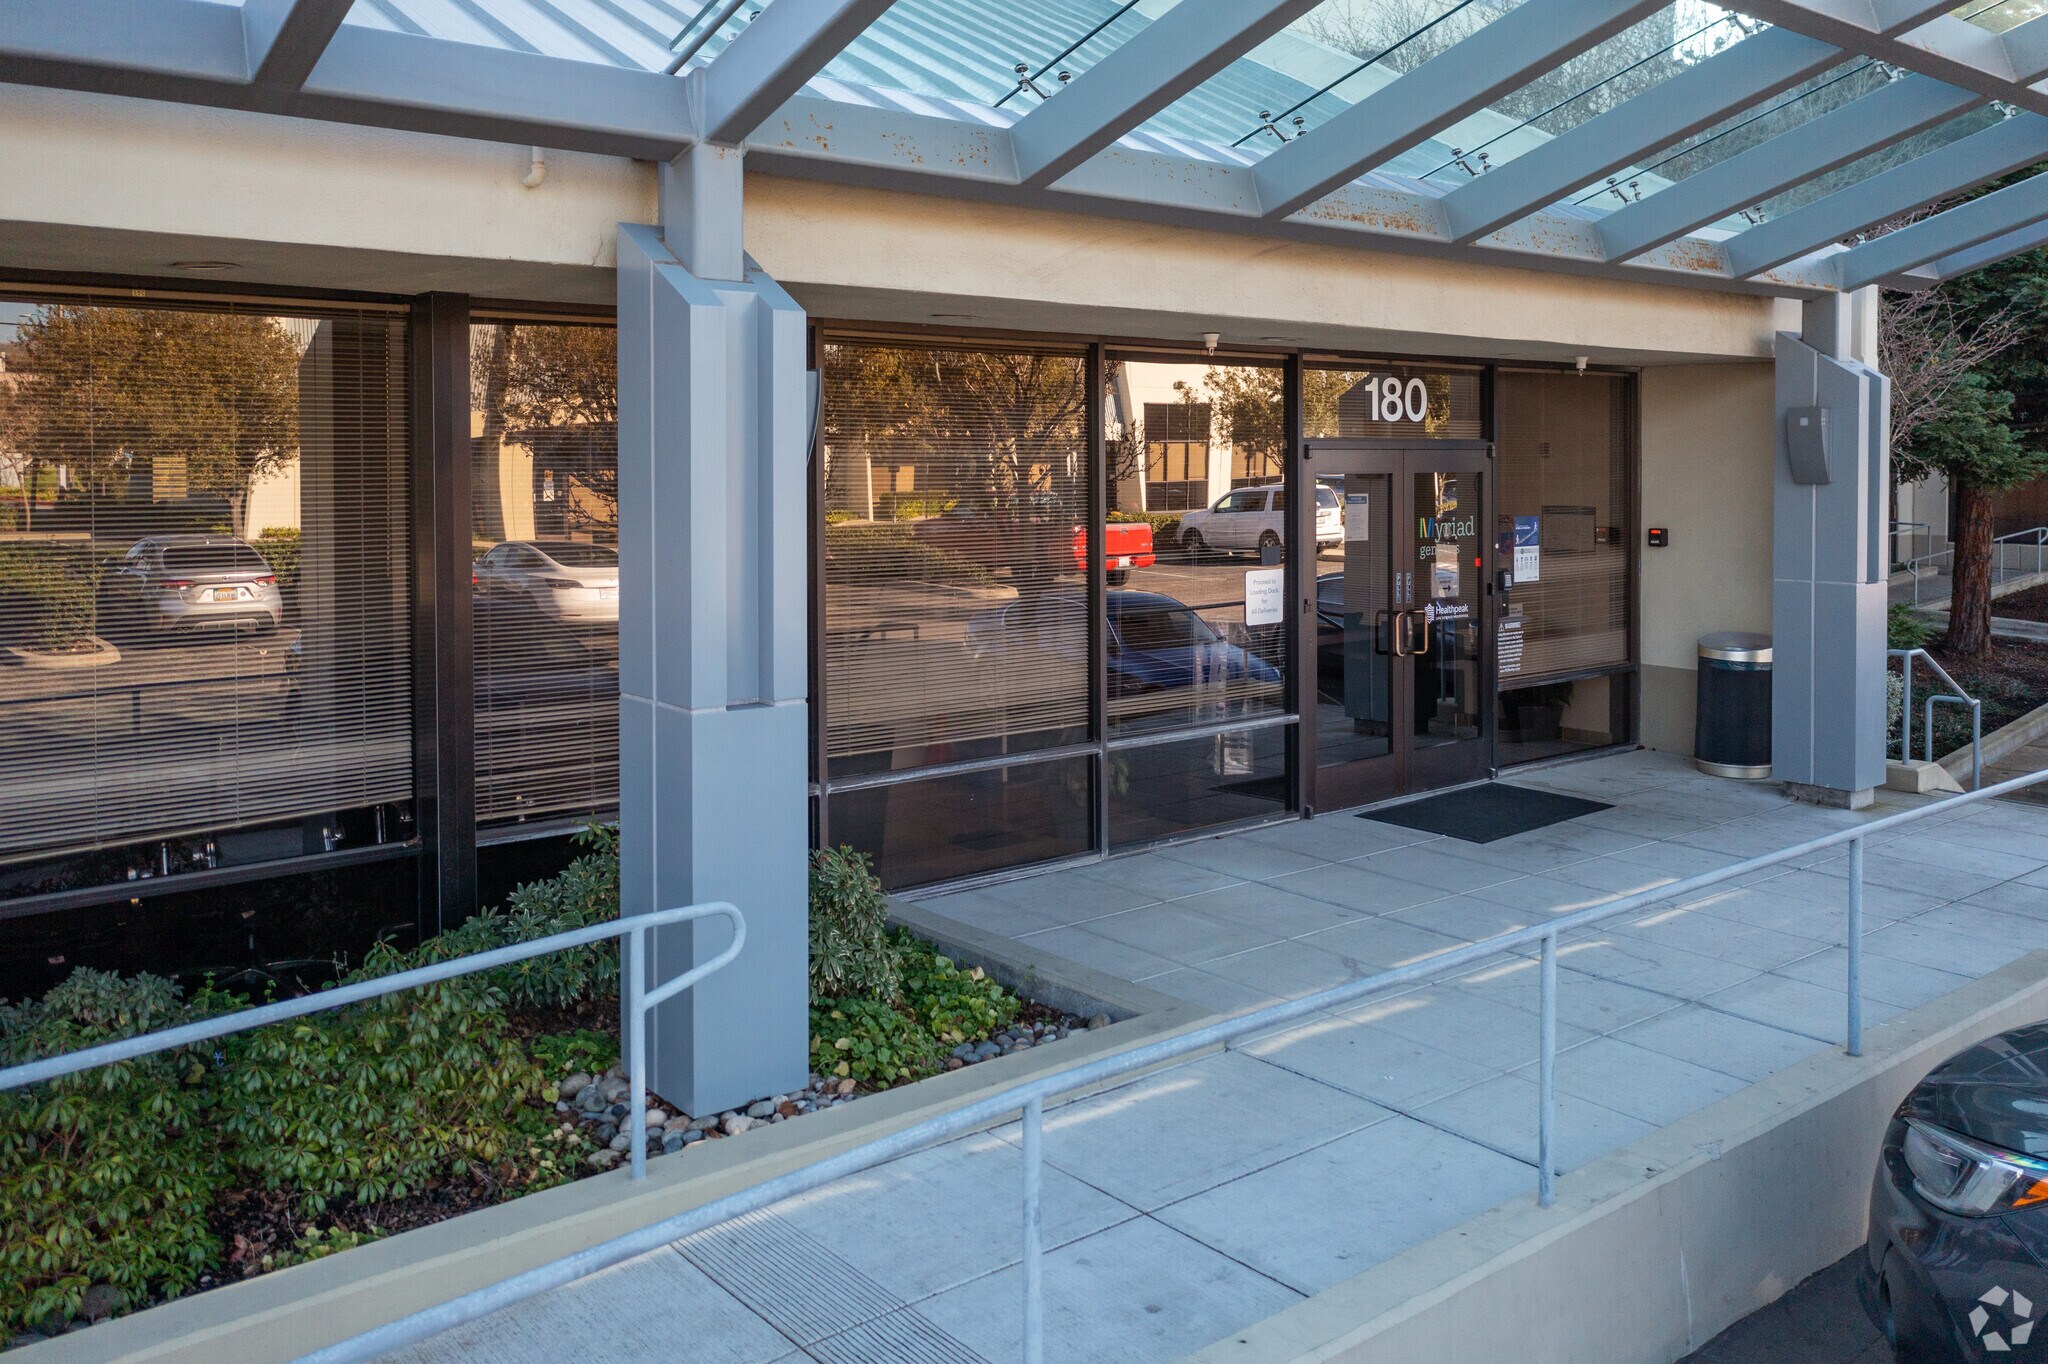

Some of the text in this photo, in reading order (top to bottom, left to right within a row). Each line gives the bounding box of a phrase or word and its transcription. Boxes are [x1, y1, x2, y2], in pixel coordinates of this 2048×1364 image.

[1364, 377, 1428, 423] 180
[1419, 515, 1476, 543] Myriad
[1435, 603, 1469, 615] Healthpeak
